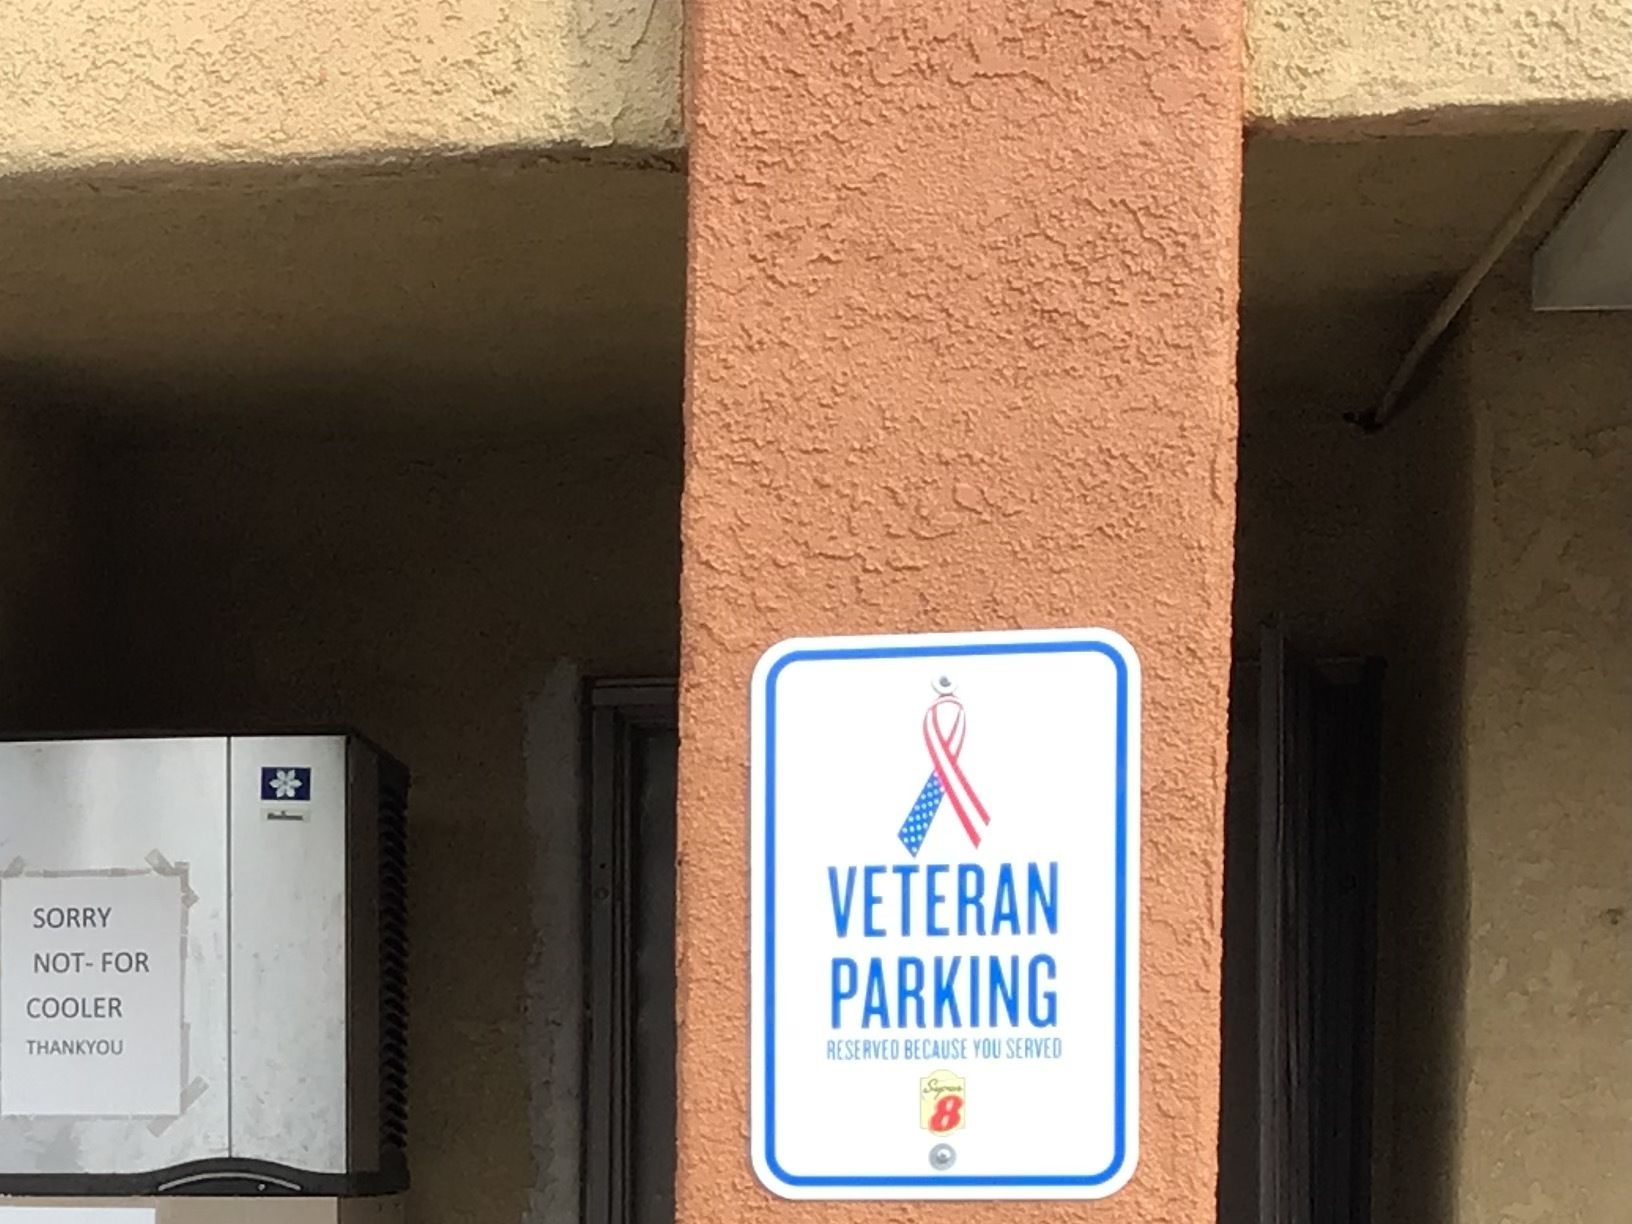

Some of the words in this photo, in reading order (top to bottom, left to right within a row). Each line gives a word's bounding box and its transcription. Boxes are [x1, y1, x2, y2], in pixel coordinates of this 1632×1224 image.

[827, 861, 1059, 939] VETERAN
[32, 906, 112, 929] SORRY
[32, 952, 94, 974] NOT-
[100, 951, 150, 974] FOR
[830, 953, 1059, 1030] PARKING
[25, 996, 123, 1020] COOLER
[26, 1038, 124, 1057] THANKYOU
[826, 1038, 900, 1061] RESERVED
[904, 1037, 968, 1061] BECAUSE
[973, 1037, 1002, 1060] YOU
[1005, 1036, 1063, 1060] SERVED
[928, 1095, 965, 1133] 8
